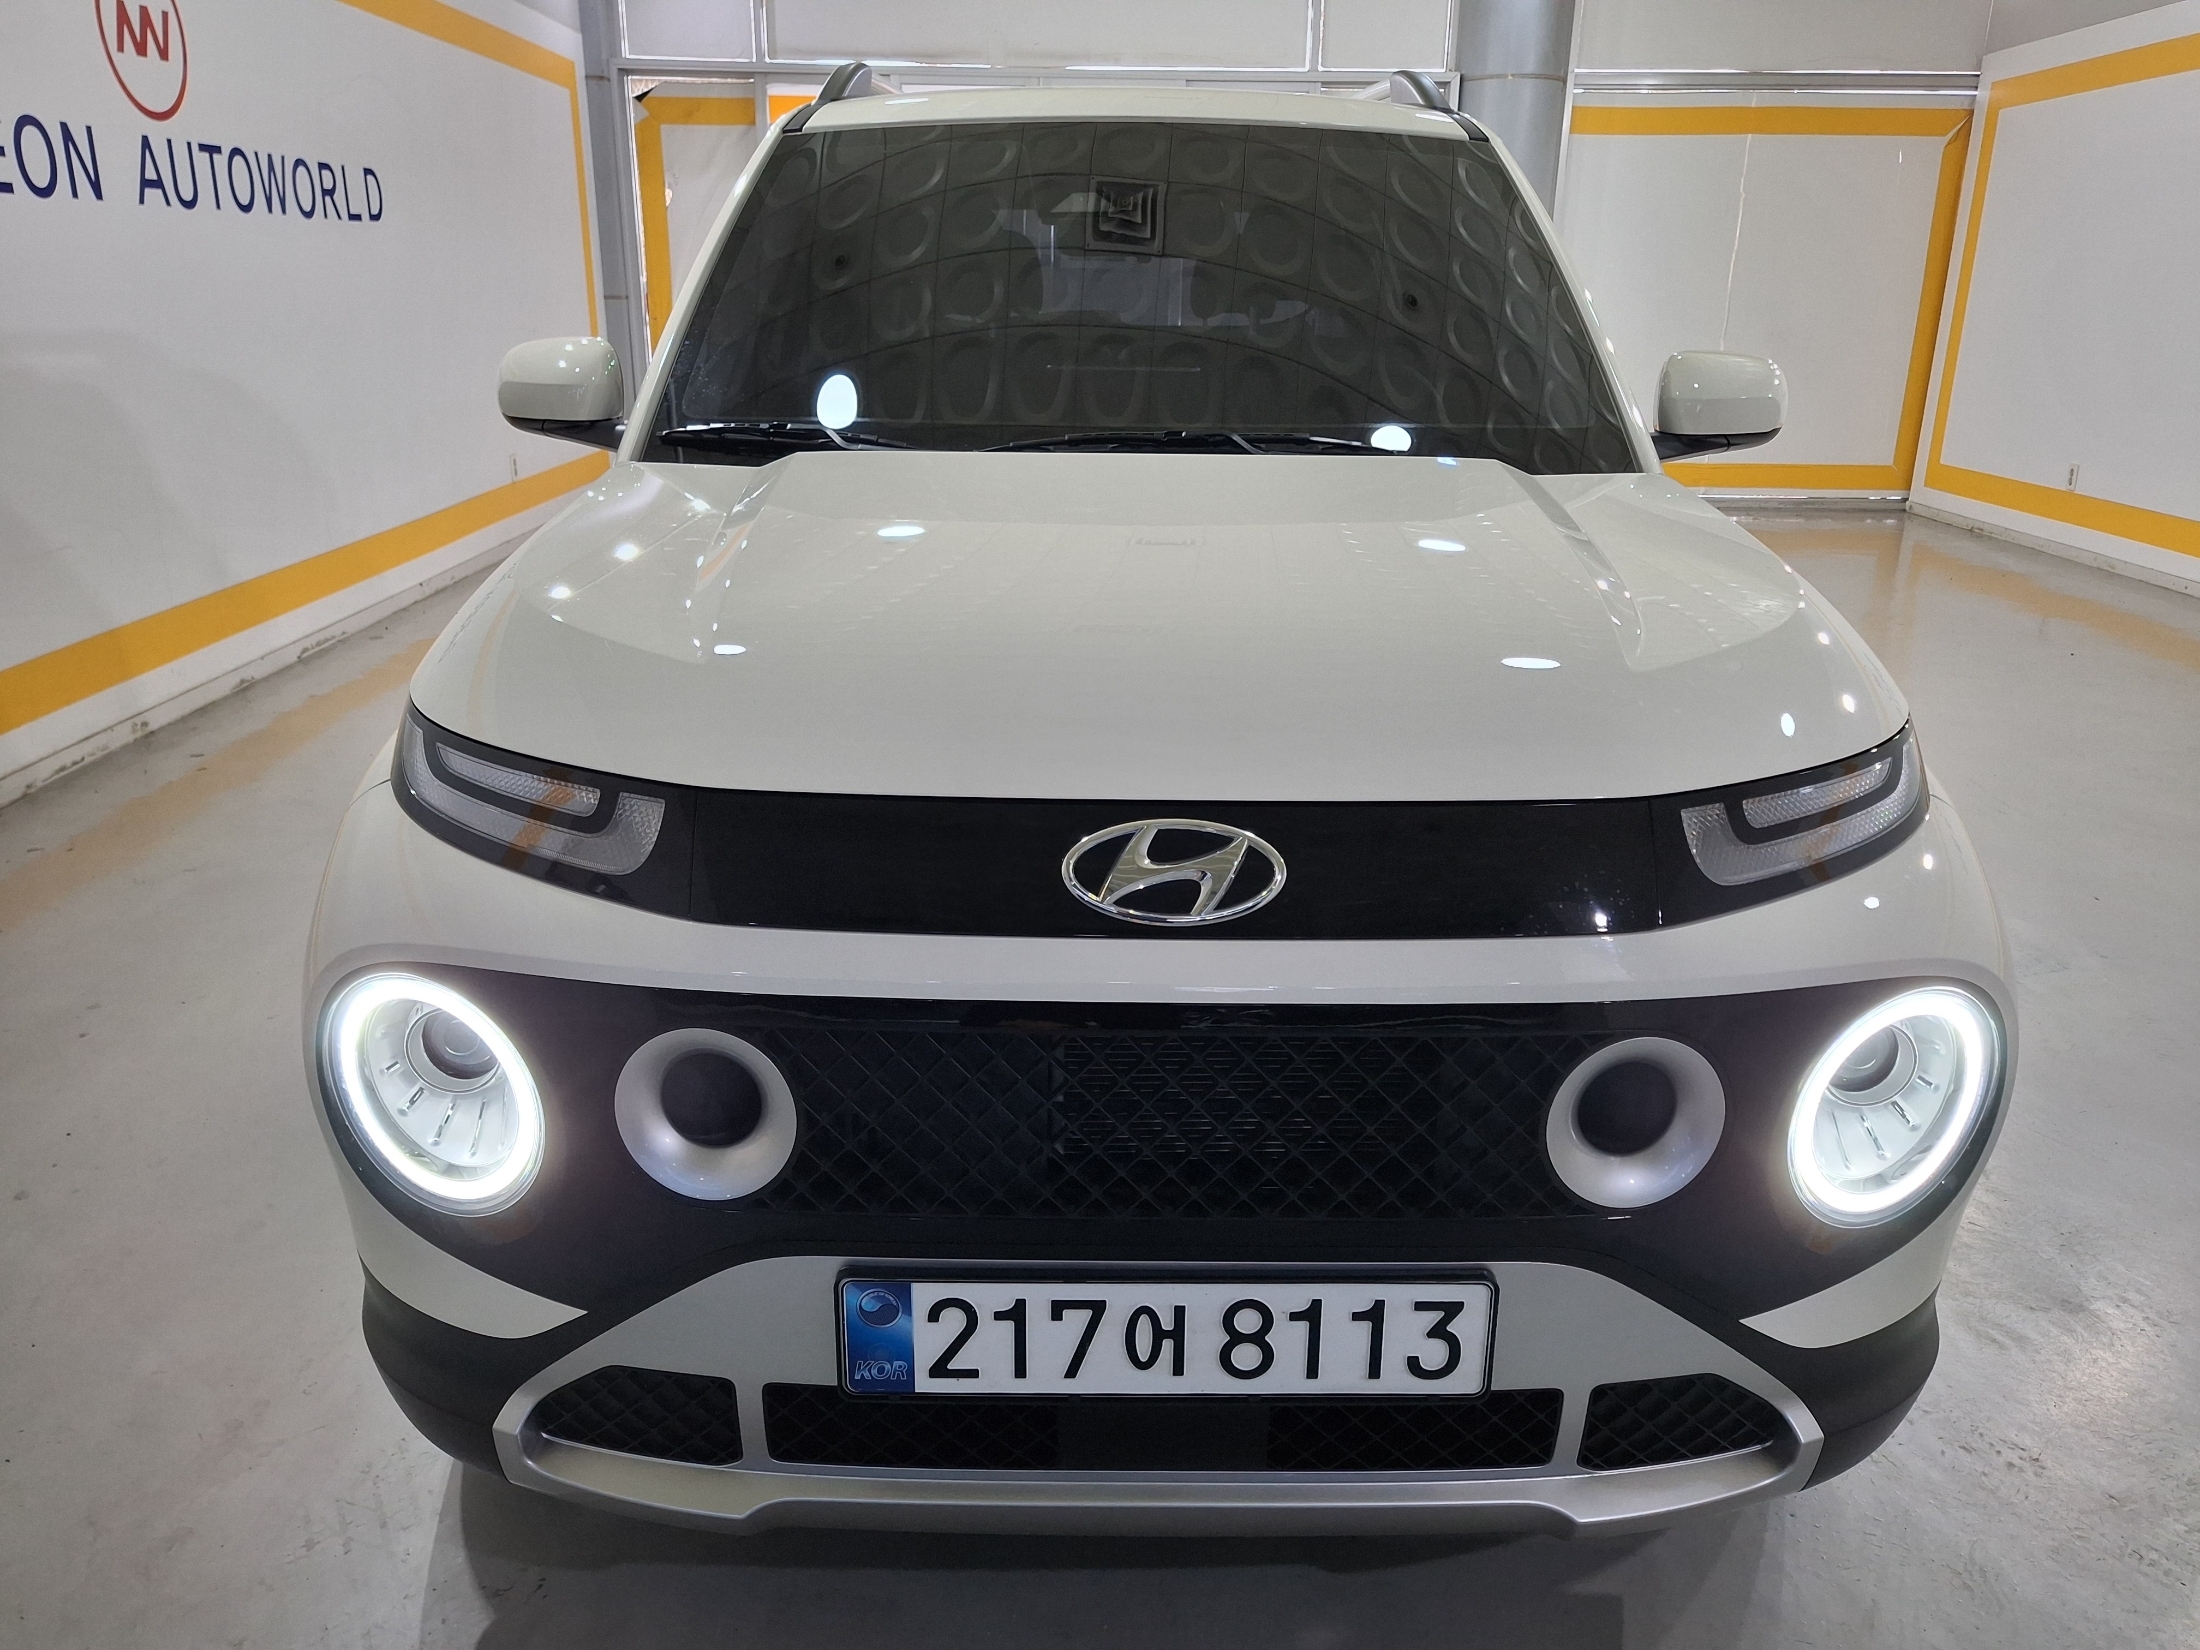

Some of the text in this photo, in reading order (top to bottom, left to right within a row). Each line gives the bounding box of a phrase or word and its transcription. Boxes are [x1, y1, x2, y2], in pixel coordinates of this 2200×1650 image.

[138, 134, 384, 222] AUTOWORLD
[854, 1360, 908, 1380] KOR
[1218, 1299, 1465, 1380] 8113
